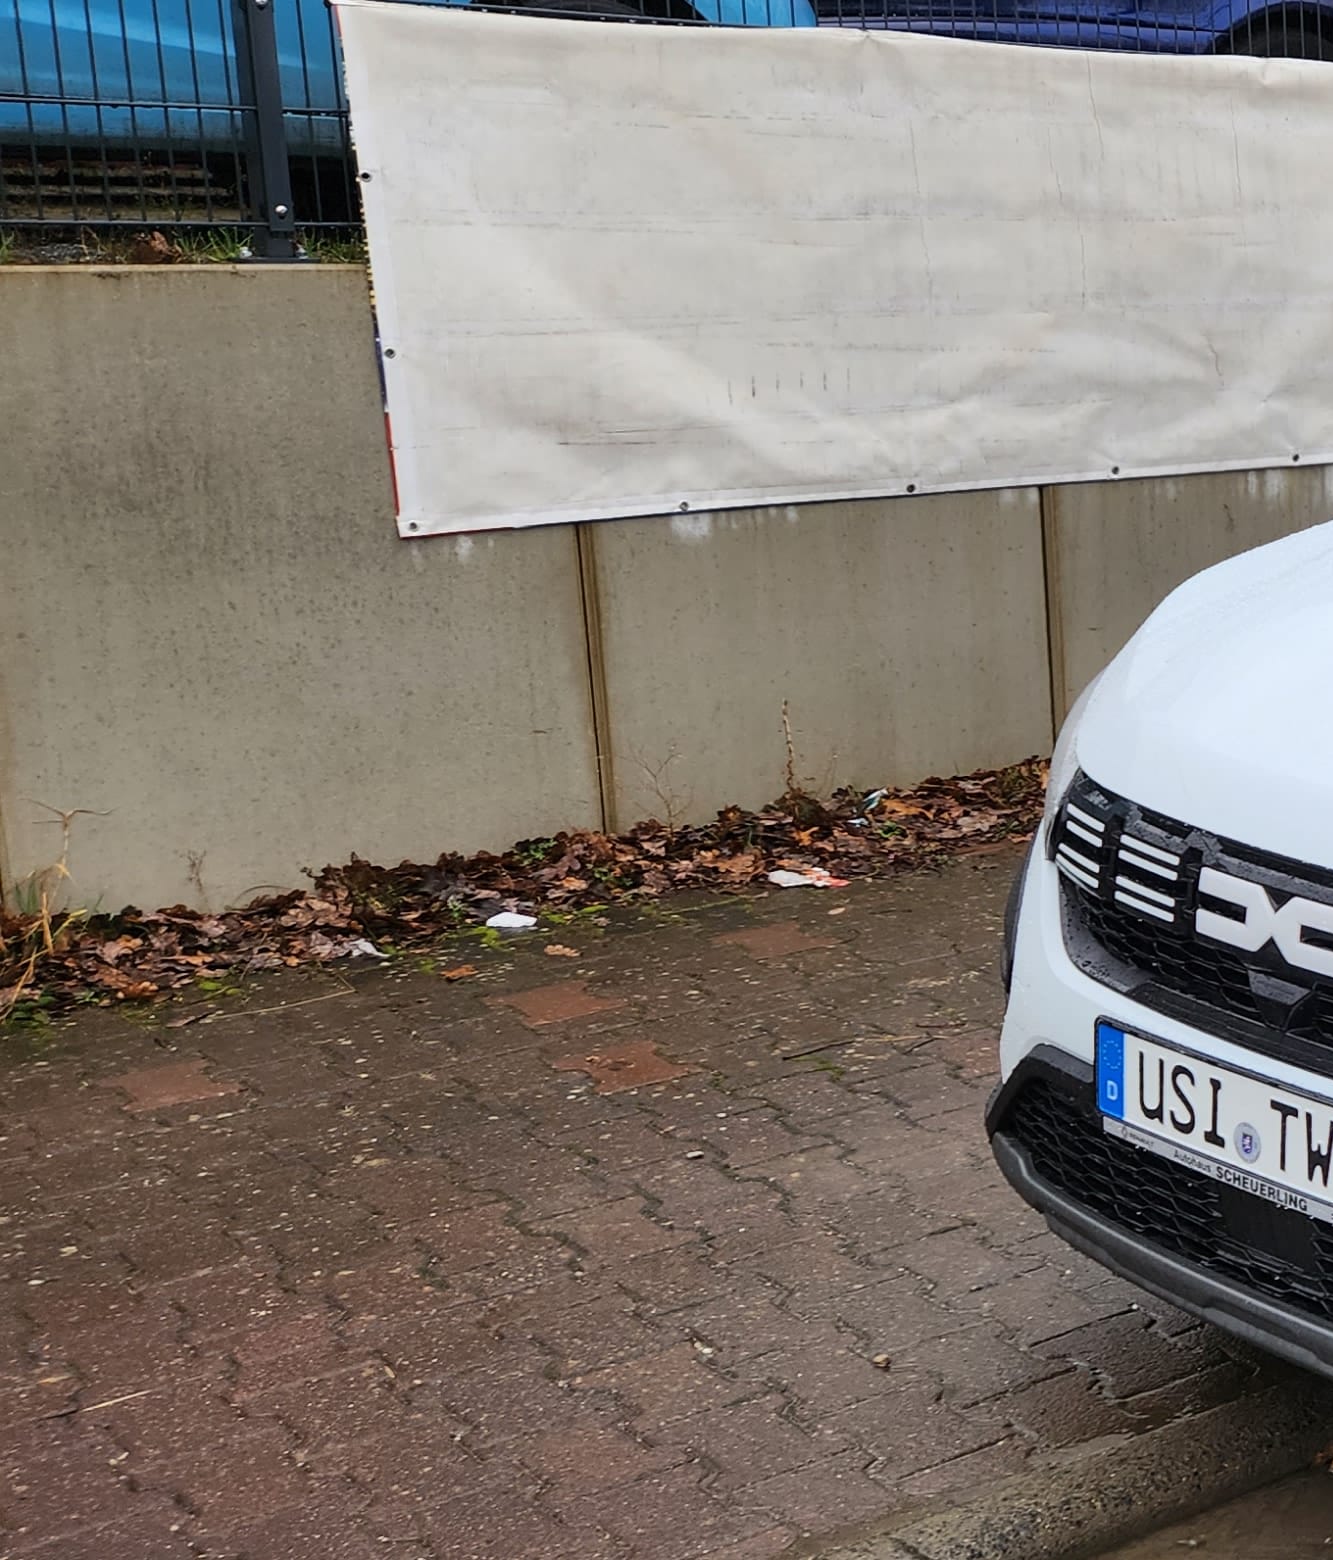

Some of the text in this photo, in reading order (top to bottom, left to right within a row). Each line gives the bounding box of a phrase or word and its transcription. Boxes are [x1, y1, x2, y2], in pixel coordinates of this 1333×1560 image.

[1106, 1080, 1118, 1101] D
[1138, 1050, 1226, 1149] USI
[1216, 1165, 1308, 1212] SCHEUERLING
